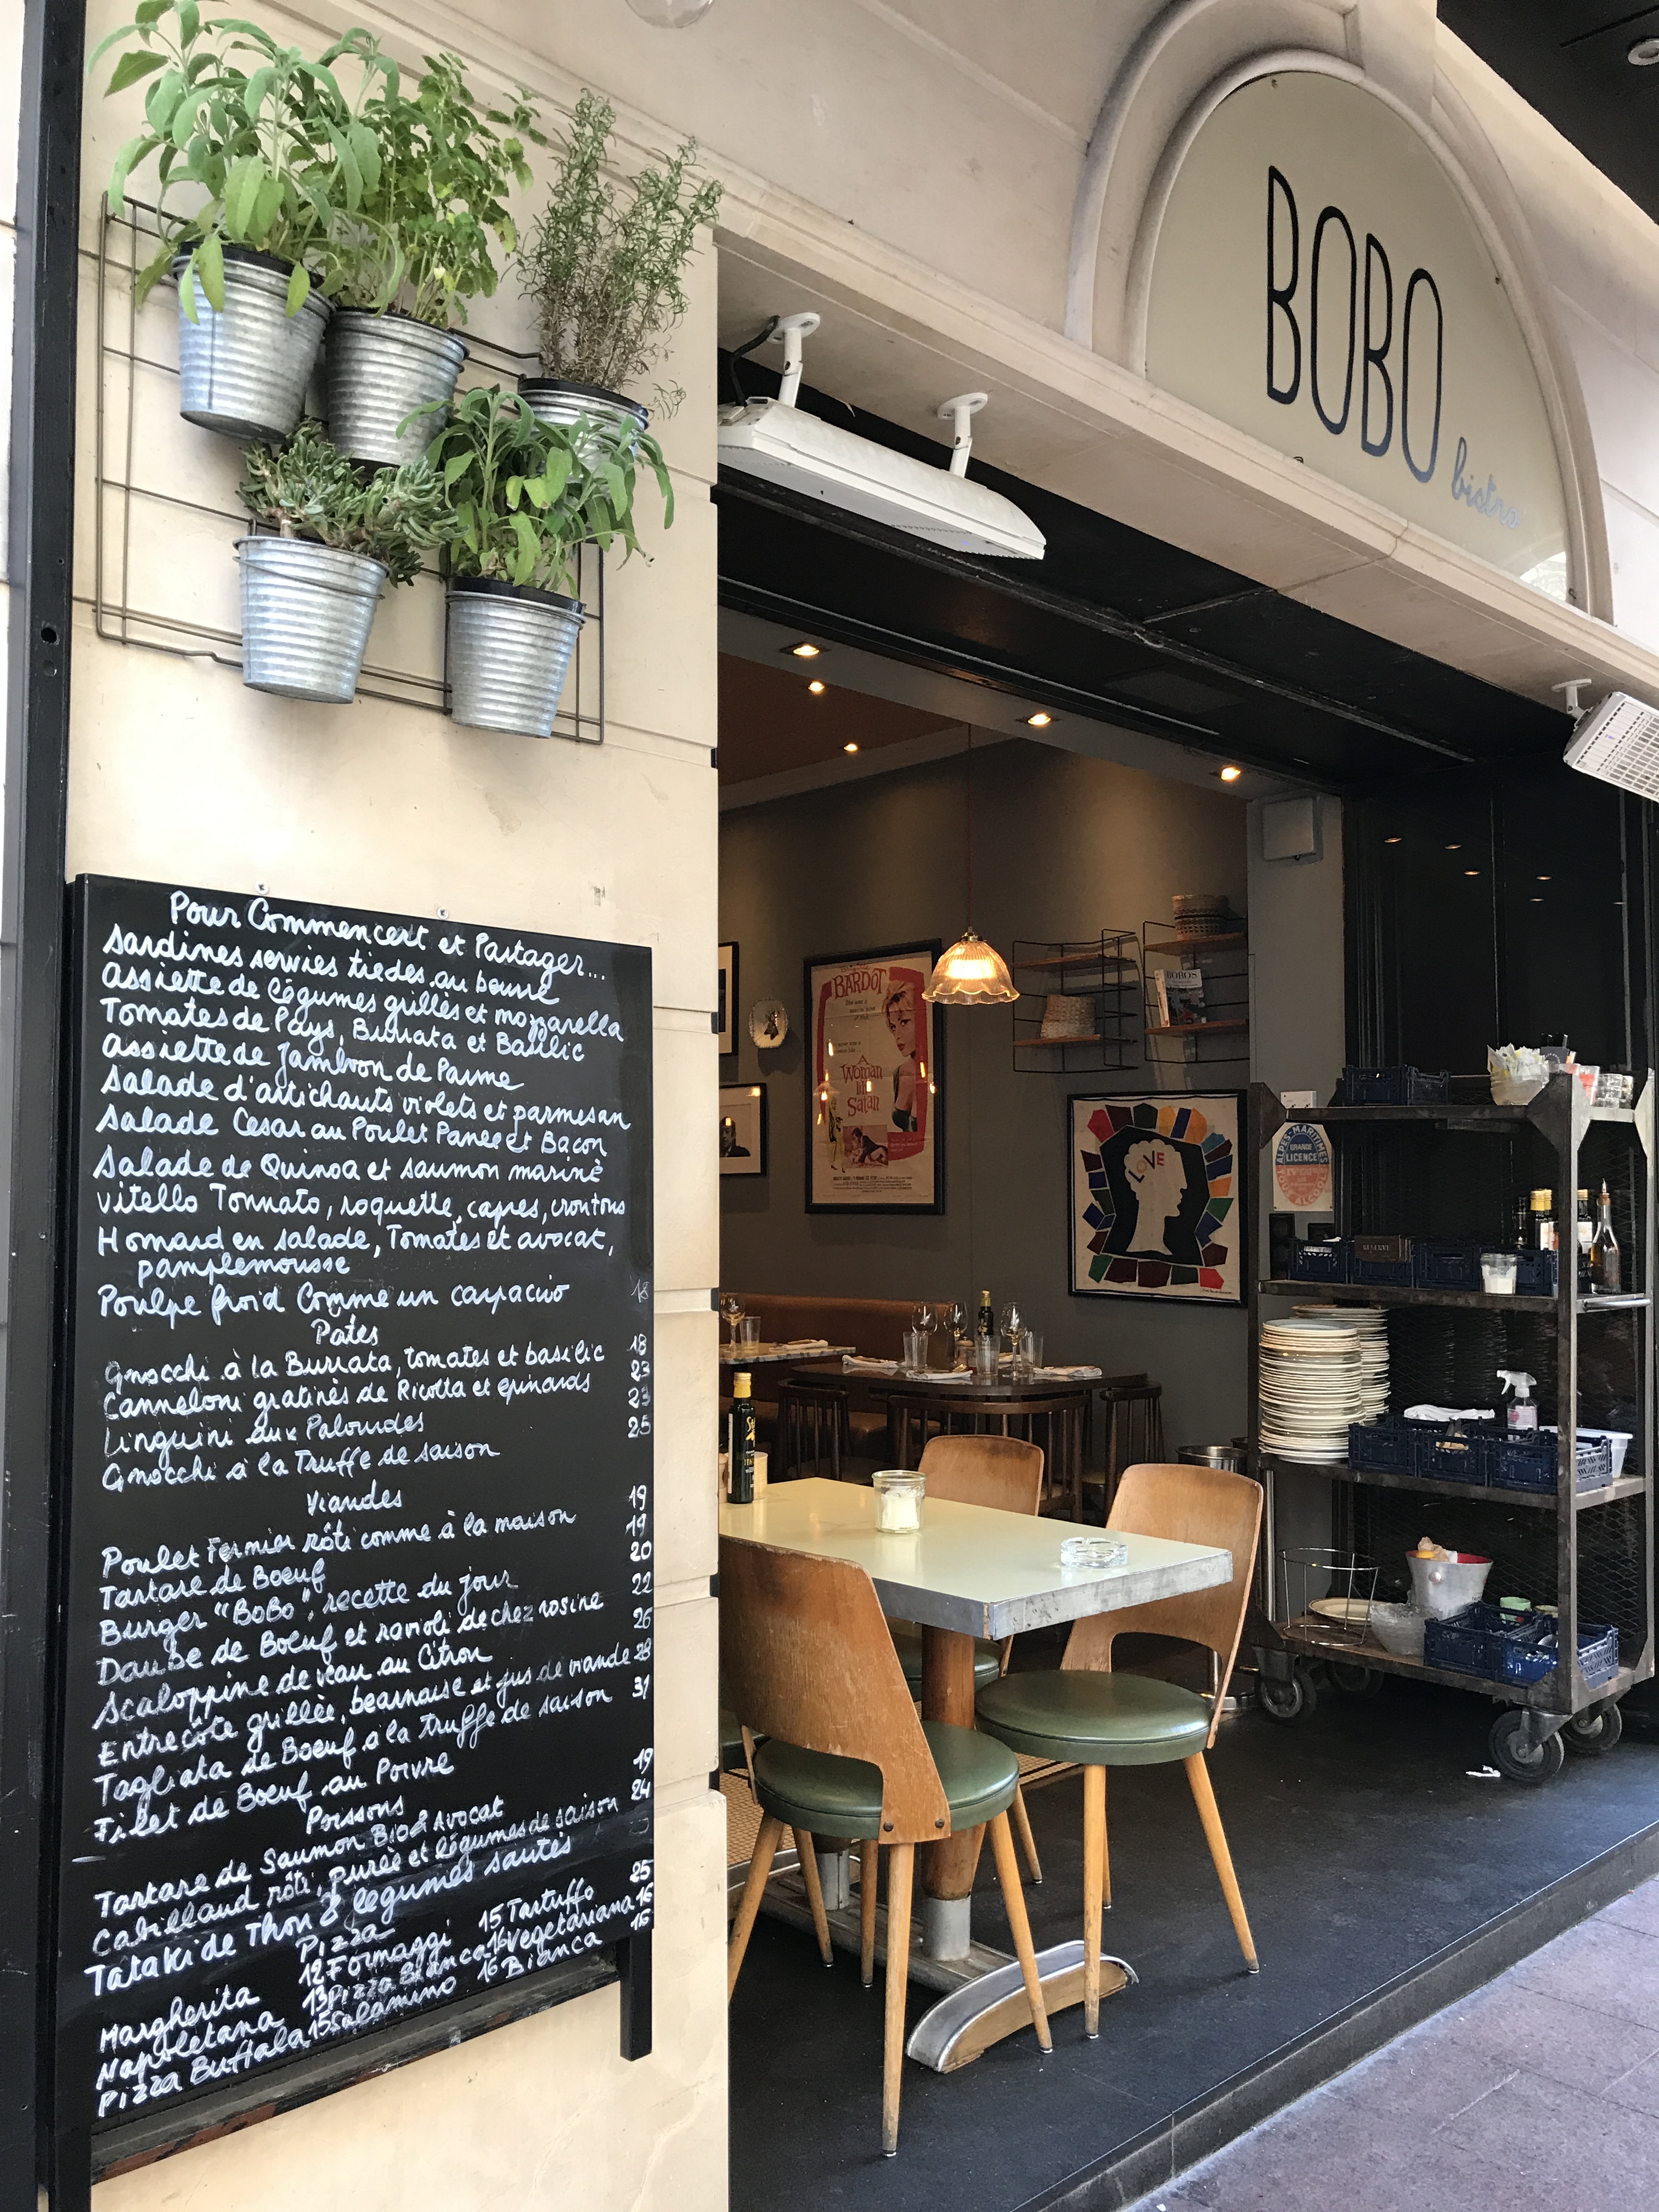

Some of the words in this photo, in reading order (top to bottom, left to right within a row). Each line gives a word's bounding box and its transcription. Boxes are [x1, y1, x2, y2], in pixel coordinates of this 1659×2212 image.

[1267, 165, 1443, 483] BOBO
[1451, 437, 1521, 529] bistro
[170, 890, 241, 928] Pour
[438, 934, 466, 956] et
[429, 970, 467, 994] au
[832, 968, 887, 1000] BARDOT
[1166, 970, 1198, 980] BOBOS
[100, 997, 228, 1028] Tomates
[233, 1006, 269, 1031] de
[467, 1032, 486, 1052] et
[228, 974, 260, 999] de
[466, 1003, 487, 1024] et
[495, 1009, 624, 1042] mozzarella
[233, 1042, 271, 1066] de
[396, 1051, 432, 1082] de
[438, 1057, 524, 1090] Parme
[839, 1063, 883, 1084] Woman
[856, 1054, 870, 1065] A
[403, 1090, 477, 1120] violets
[483, 1101, 507, 1122] et
[514, 1104, 631, 1135] parmesan
[848, 1096, 880, 1118] Satan
[311, 1121, 346, 1141] au
[352, 1116, 428, 1144] Poulet
[506, 1131, 532, 1153] et
[541, 1130, 607, 1156] Bacon
[1276, 1125, 1329, 1164] ALPES-MARITIMES
[1289, 1143, 1313, 1152] GRANDE
[222, 1154, 251, 1178] de
[261, 1148, 360, 1180] Quinoa
[368, 1158, 391, 1181] et
[400, 1156, 499, 1180] saumon
[1128, 1149, 1165, 1184] LOVE
[1286, 1153, 1318, 1162] LICENCE
[233, 1231, 264, 1250] en
[386, 1221, 479, 1251] Tomates
[487, 1224, 511, 1250] et
[138, 1252, 350, 1288] pamplemousse
[98, 1284, 201, 1329] Poulpe
[211, 1283, 285, 1325] froid
[397, 1288, 438, 1308] un
[627, 1333, 647, 1355] 18
[105, 1353, 210, 1395] Gnocchi
[251, 1354, 278, 1378] la
[404, 1344, 490, 1369] tomates
[498, 1345, 516, 1366] et
[524, 1340, 605, 1365] basilic
[630, 1359, 651, 1383] 23
[357, 1386, 388, 1403] de
[397, 1376, 466, 1402] Ricotta
[472, 1379, 490, 1396] et
[628, 1415, 651, 1438] 25
[102, 1454, 216, 1493] Gnocchi
[258, 1452, 288, 1476] la
[295, 1446, 371, 1477] Truffe
[378, 1443, 410, 1466] de
[414, 1440, 500, 1463] saison
[629, 1485, 647, 1512] 19
[101, 1544, 200, 1579] Poulet
[361, 1523, 431, 1550] comme
[464, 1511, 487, 1536] la
[495, 1508, 577, 1534] maison
[625, 1514, 647, 1537] 19
[630, 1540, 652, 1562] 20
[99, 1579, 208, 1611] Tartare
[210, 1565, 246, 1595] de
[631, 1571, 652, 1595] 22
[100, 1611, 207, 1653] Burger
[323, 1579, 410, 1615] recette
[417, 1572, 452, 1599] du
[457, 1566, 518, 1616] jour
[633, 1607, 652, 1630] 26
[211, 1638, 249, 1666] de
[345, 1620, 366, 1646] et
[457, 1606, 487, 1634] de
[491, 1600, 534, 1627] chez
[275, 1664, 311, 1694] de
[377, 1654, 411, 1677] au
[471, 1671, 493, 1695] et
[538, 1662, 564, 1682] de
[632, 1674, 650, 1700] 31
[241, 1753, 276, 1776] de
[386, 1720, 411, 1743] la
[500, 1699, 531, 1723] de
[538, 1689, 613, 1718] saison
[188, 1795, 230, 1825] de
[321, 1773, 366, 1796] au
[376, 1752, 454, 1785] Poivre
[631, 1779, 652, 1801] 24
[409, 1844, 429, 1867] et
[528, 1811, 550, 1835] de
[94, 1874, 210, 1918] Tartare
[216, 1860, 252, 1888] de
[260, 1833, 365, 1875] Saumon
[630, 1859, 653, 1882] 25
[201, 1933, 236, 1961] de
[245, 1911, 313, 1947] Thon
[298, 1958, 324, 1987] 12
[478, 1905, 504, 1932] 15
[507, 1877, 594, 1922] Tartuffo
[302, 1986, 327, 2017] 13
[487, 1927, 508, 1955] 16
[98, 2072, 183, 2118] Pizza
[308, 2008, 331, 2040] 15
[477, 1958, 498, 1983] 16
[500, 1931, 603, 1979] Bianca
